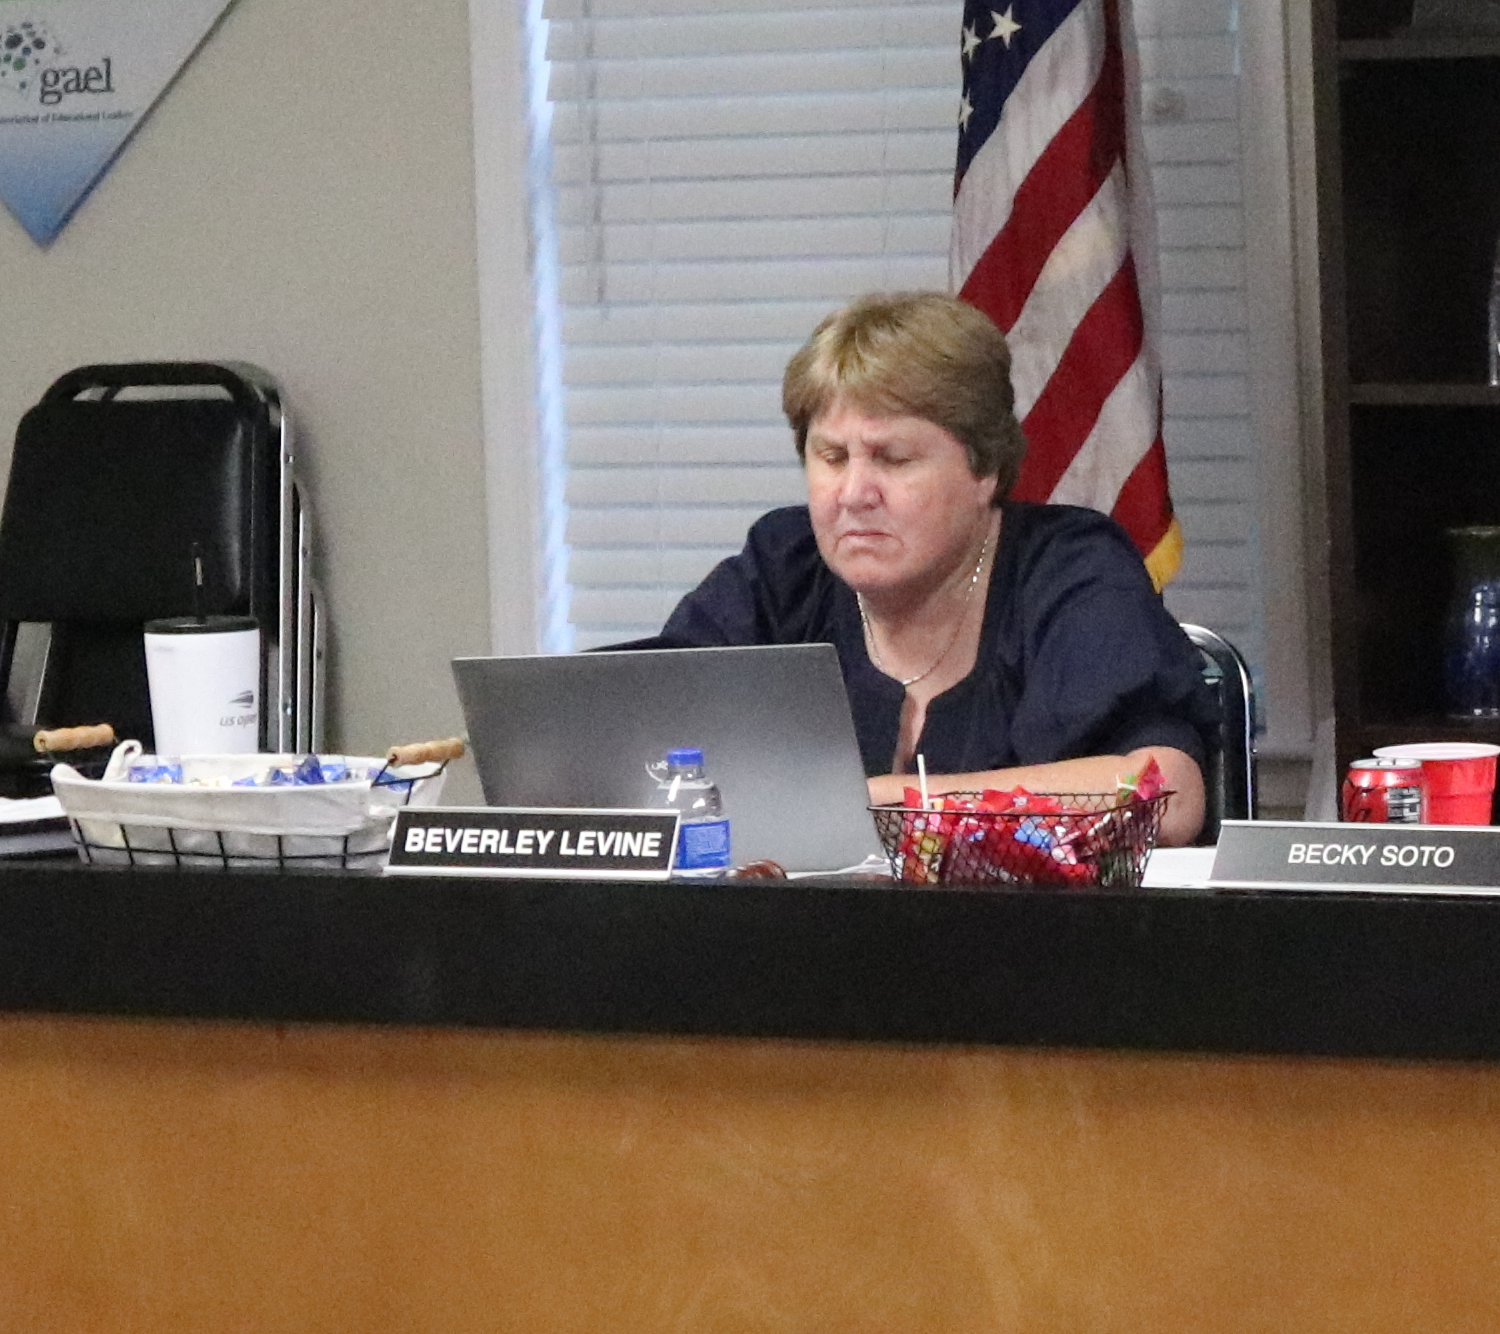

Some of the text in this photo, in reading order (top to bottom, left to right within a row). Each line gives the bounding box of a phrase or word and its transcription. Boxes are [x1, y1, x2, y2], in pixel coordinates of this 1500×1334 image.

[39, 58, 116, 105] gael
[404, 828, 554, 855] BEVERLEY
[559, 830, 662, 857] LEVINE
[1287, 843, 1455, 868] BECKY SOTO
